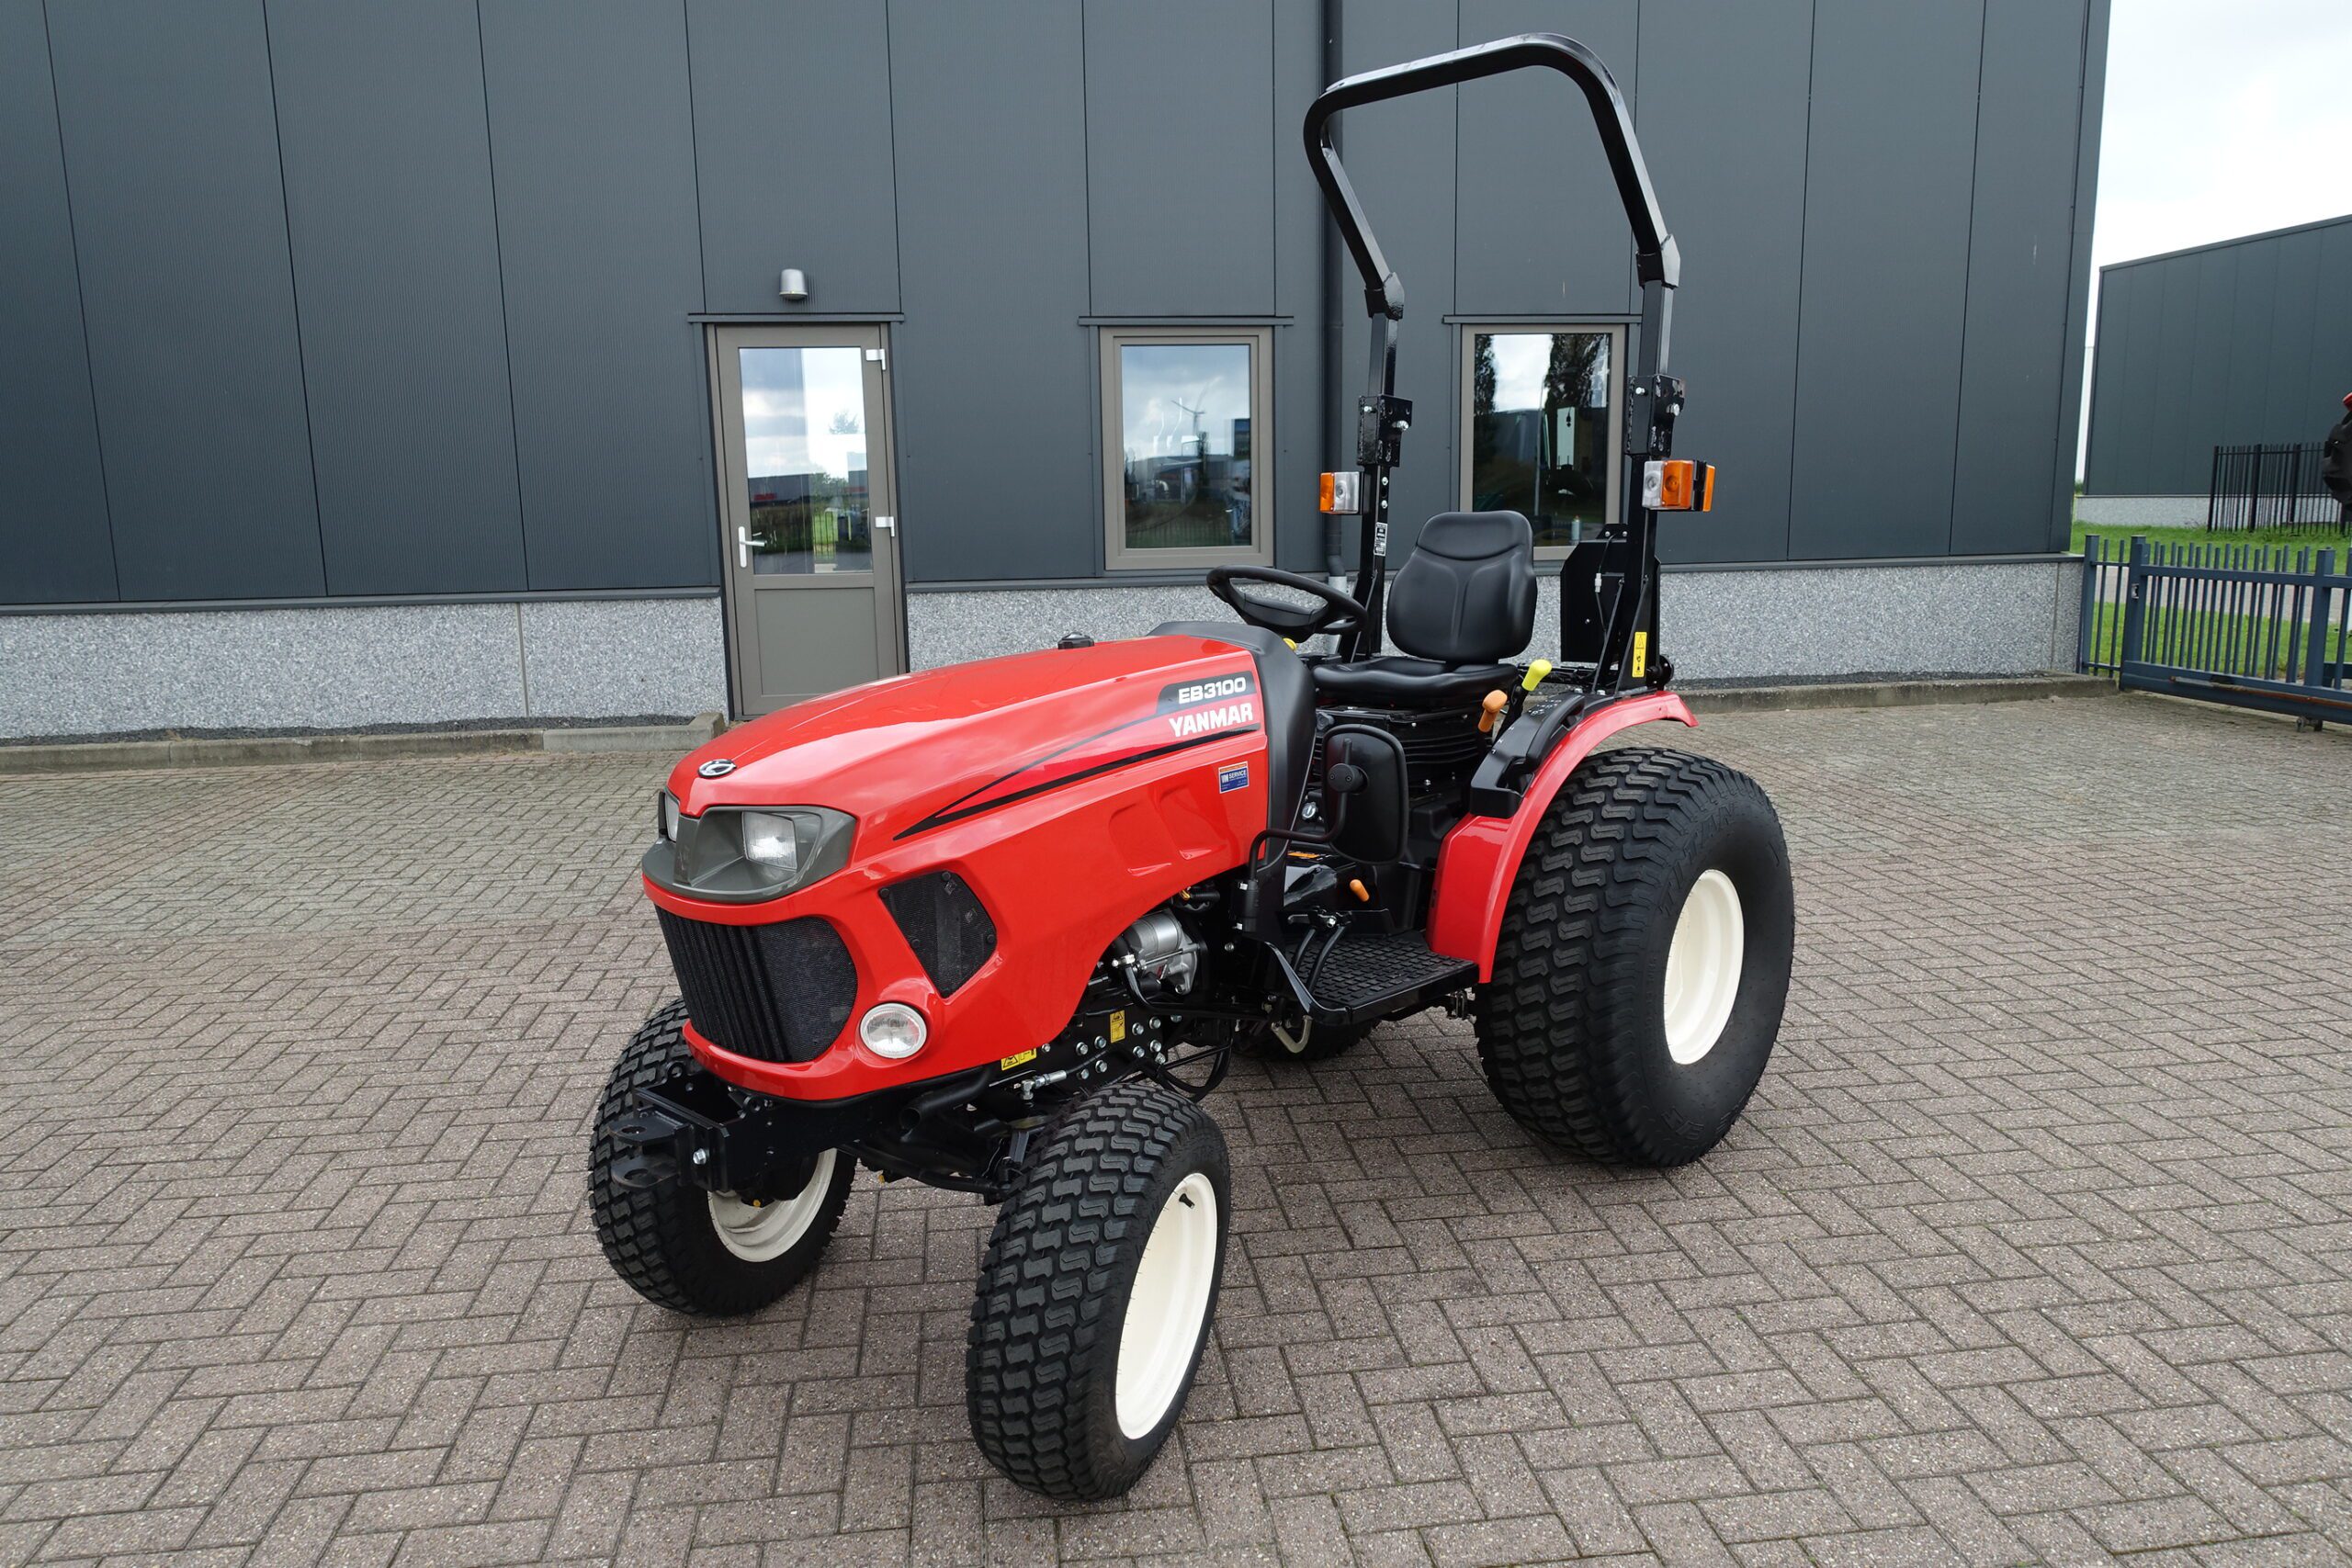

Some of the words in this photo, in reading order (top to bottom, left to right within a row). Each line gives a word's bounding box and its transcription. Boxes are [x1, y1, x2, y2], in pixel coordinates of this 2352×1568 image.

[1178, 676, 1247, 705] EB3100
[1168, 702, 1253, 738] YANMAR
[1228, 769, 1247, 780] SERVICE
